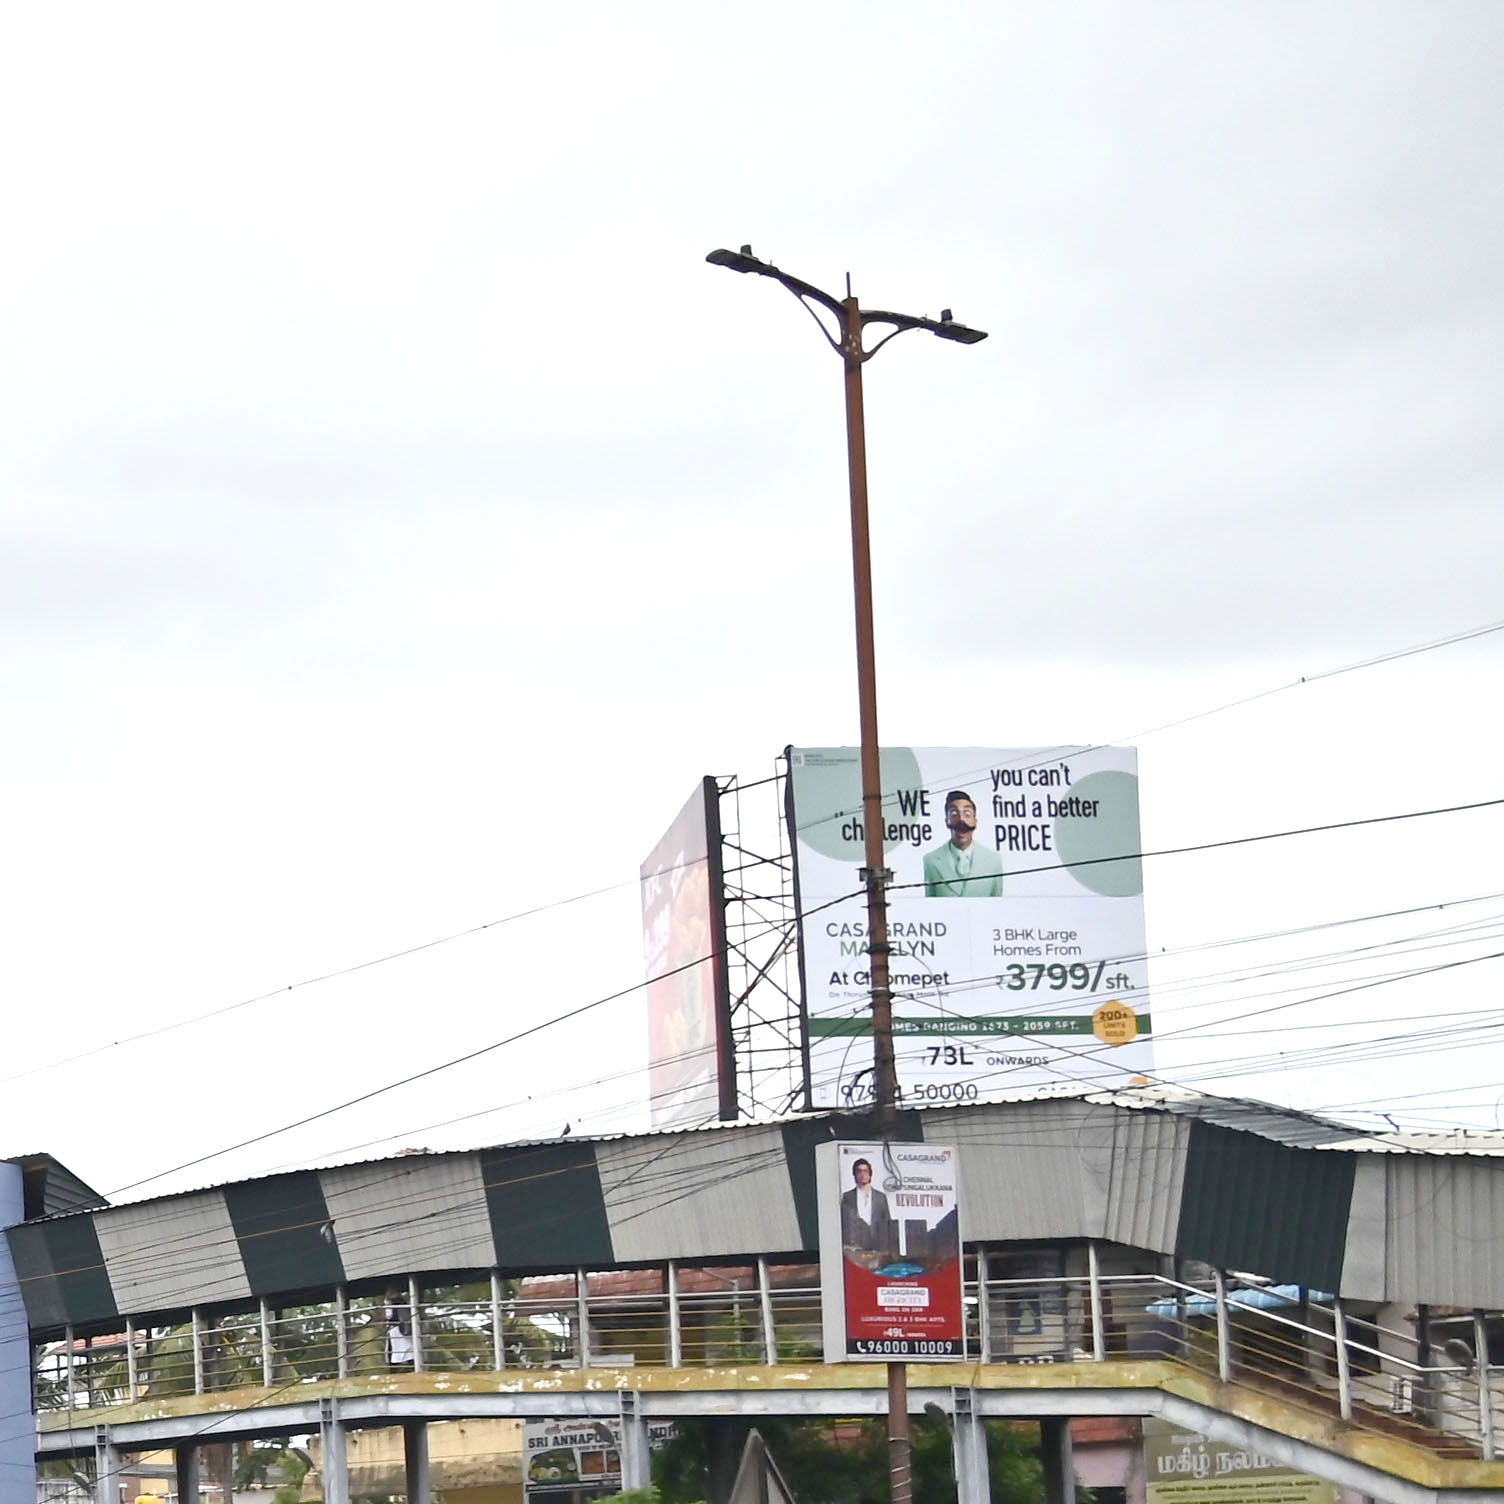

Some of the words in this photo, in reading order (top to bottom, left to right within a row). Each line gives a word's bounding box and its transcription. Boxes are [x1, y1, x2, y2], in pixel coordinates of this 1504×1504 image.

[991, 768, 1023, 792] you
[1028, 763, 1072, 787] can't
[897, 789, 931, 817] WE
[992, 795, 1026, 818] find
[1032, 801, 1042, 818] a
[1048, 796, 1099, 818] better
[841, 817, 932, 847] chlenge
[995, 825, 1052, 851] PRICE
[992, 929, 1001, 941] 3
[1005, 929, 1034, 941] BHK
[1038, 929, 1077, 943] Large
[840, 940, 935, 956] MAELYN
[993, 944, 1042, 956] Homes
[1045, 944, 1082, 955] From
[829, 971, 849, 985] At
[987, 1056, 1049, 1066] ONWARDS
[913, 1084, 978, 1100] 50000
[867, 1341, 909, 1354] 96000
[914, 1341, 953, 1354] 10009
[528, 1436, 549, 1449] SRI
